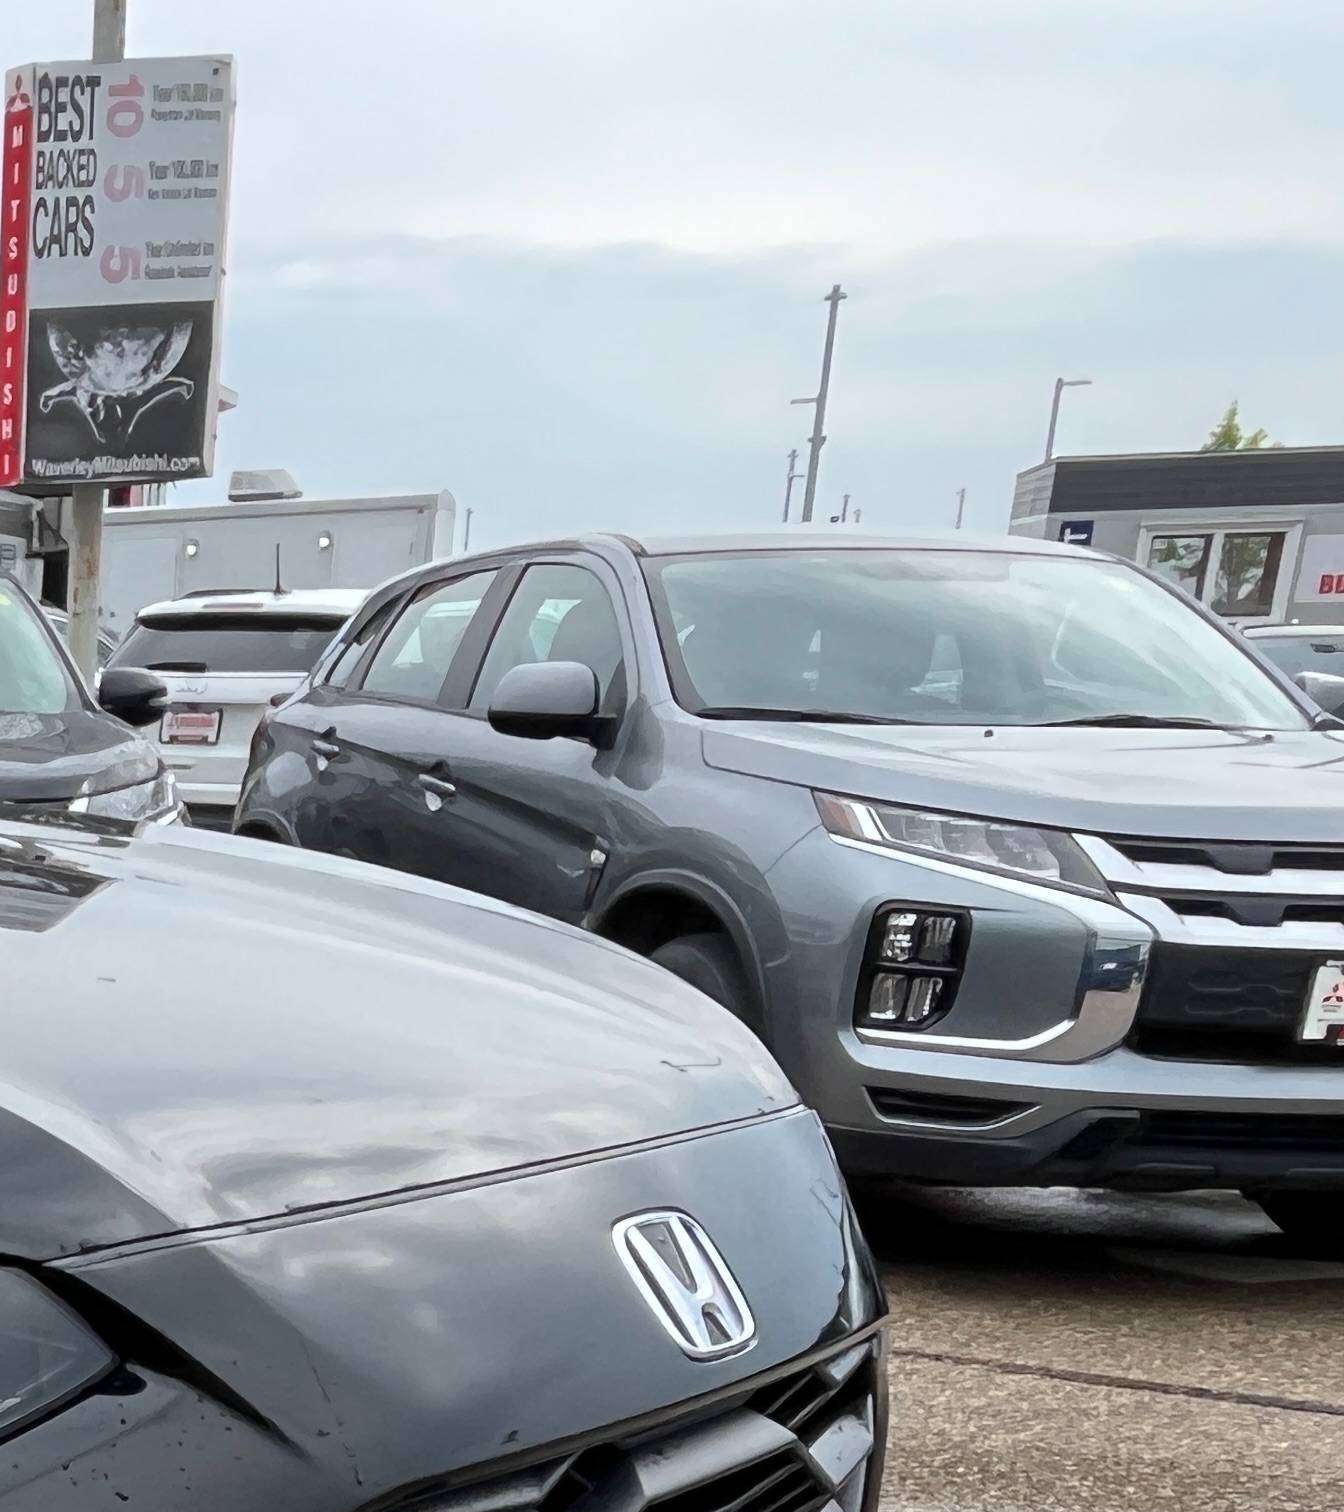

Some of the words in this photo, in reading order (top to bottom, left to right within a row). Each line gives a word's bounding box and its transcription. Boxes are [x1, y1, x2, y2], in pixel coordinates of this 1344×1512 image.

[37, 72, 101, 143] BEST
[107, 74, 145, 138] 10
[35, 148, 97, 190] BACKED
[32, 194, 95, 259] CARS
[1, 124, 24, 475] MITSUBISHI
